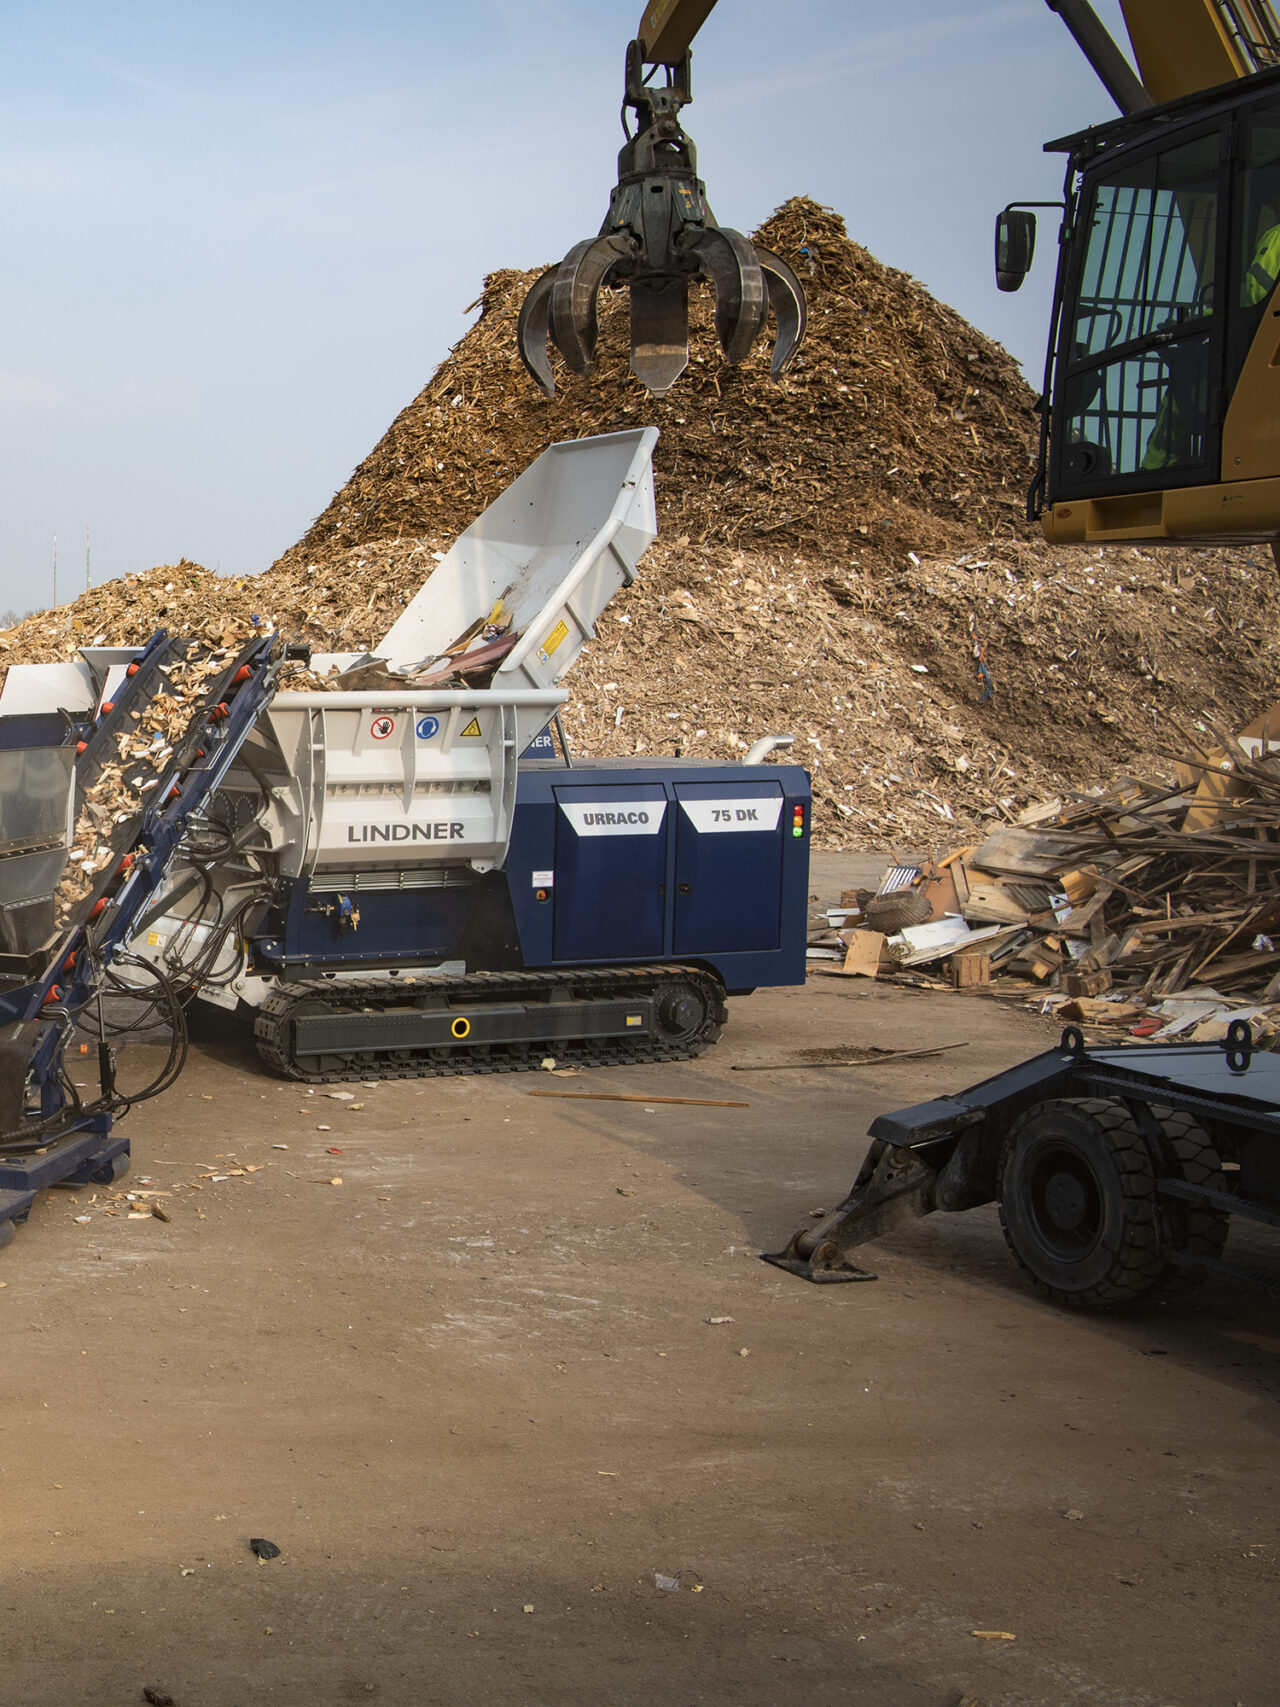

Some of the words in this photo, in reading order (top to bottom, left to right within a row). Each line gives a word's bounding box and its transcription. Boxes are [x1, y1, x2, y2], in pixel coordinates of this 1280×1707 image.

[583, 811, 649, 826] URRACO
[711, 809, 732, 822] 75
[736, 808, 759, 821] DK
[347, 822, 465, 842] LINDNER
